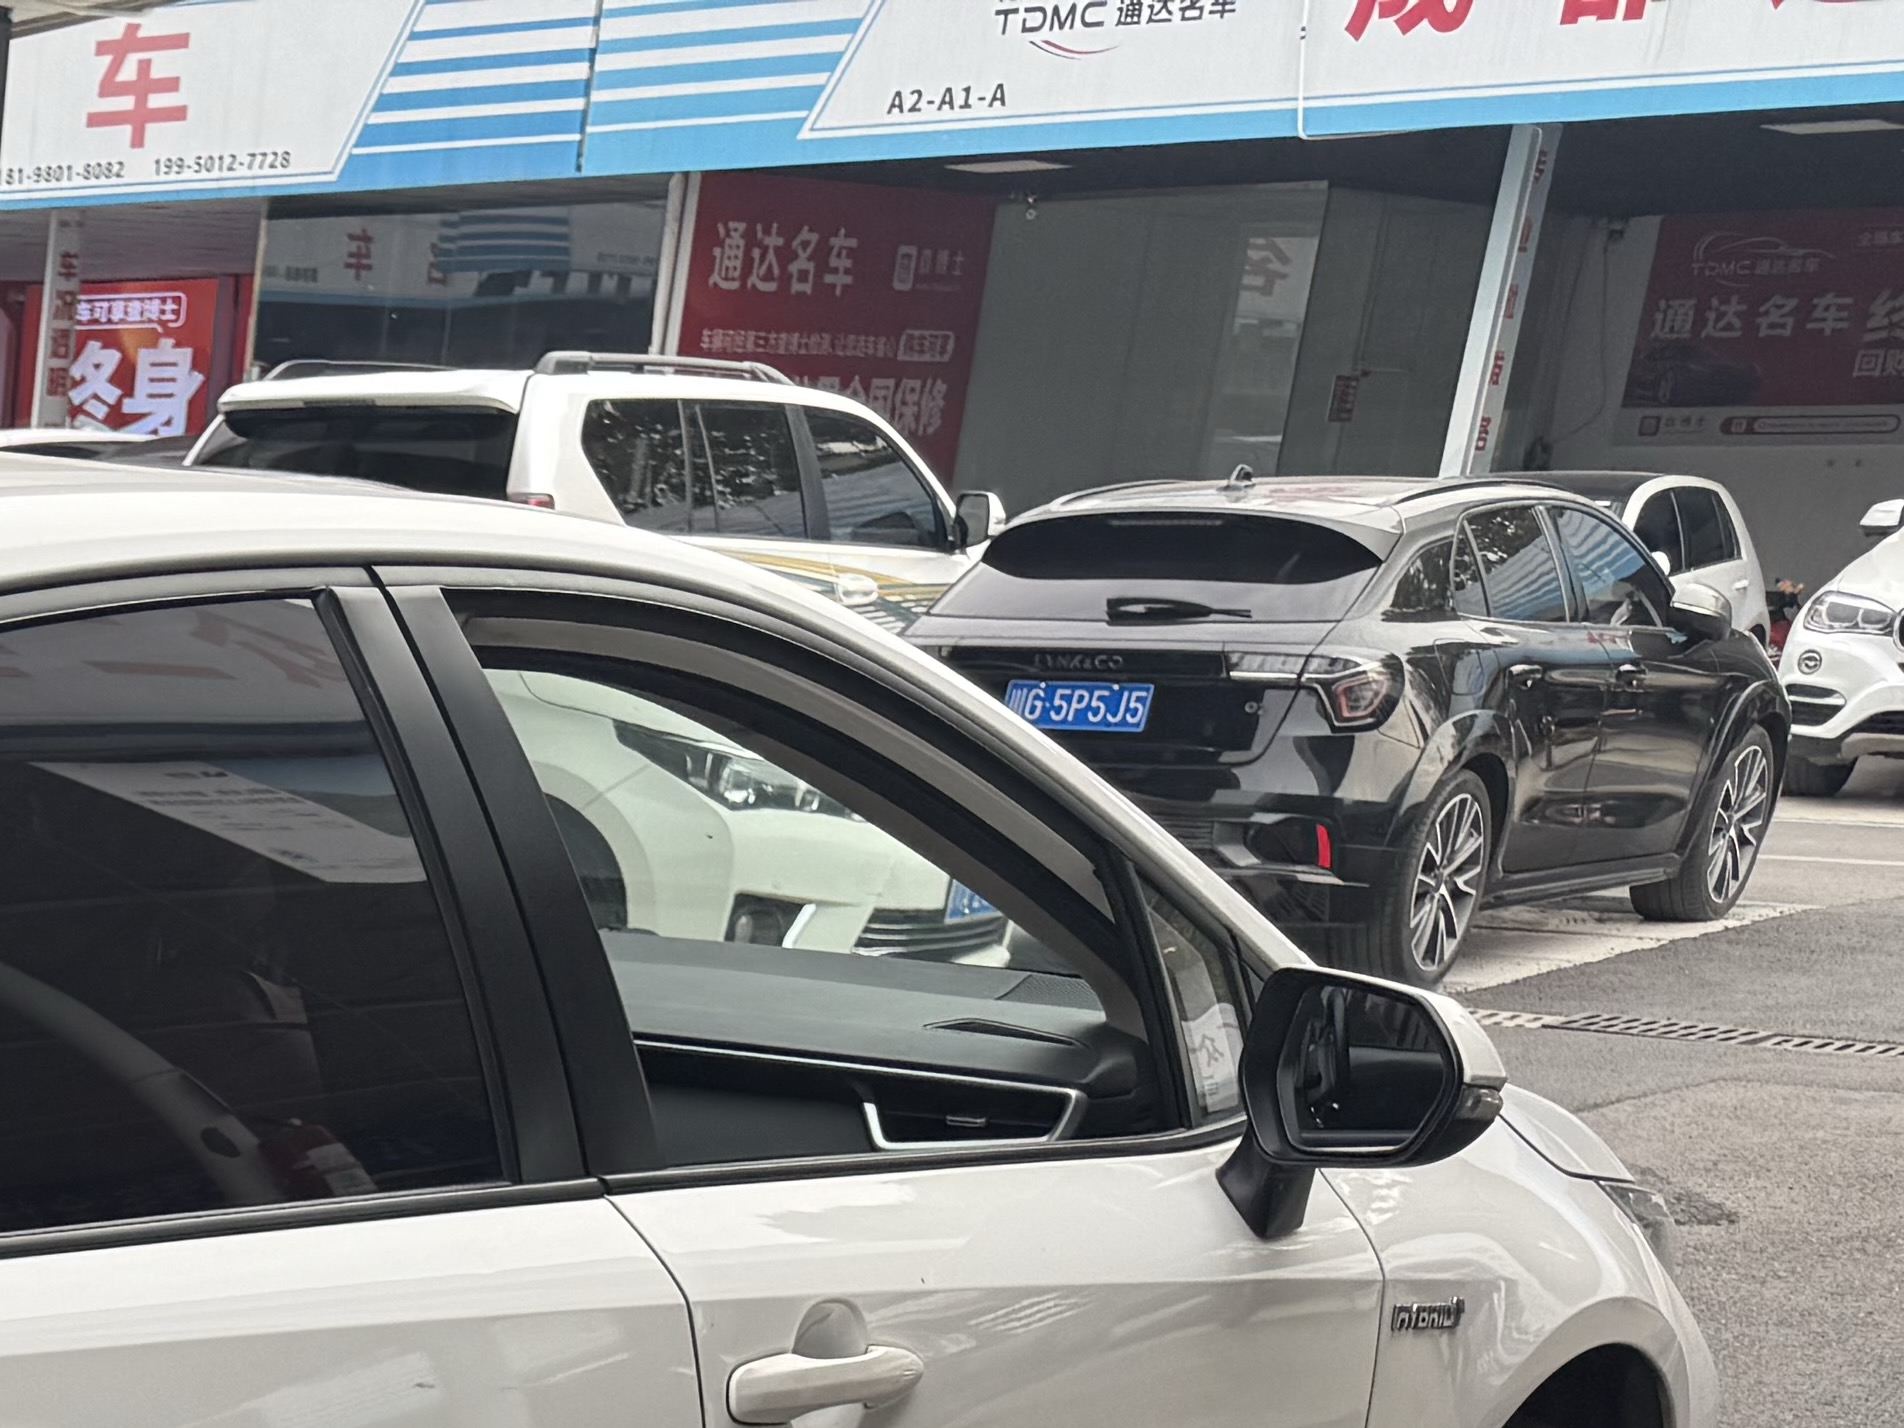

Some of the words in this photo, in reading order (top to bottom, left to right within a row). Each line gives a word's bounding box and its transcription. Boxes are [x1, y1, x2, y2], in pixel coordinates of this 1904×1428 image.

[994, 0, 1108, 35] TDMC
[86, 22, 191, 149] 车
[887, 83, 1007, 115] A2-A1-A
[154, 151, 292, 177] 199-5012-7728
[708, 221, 859, 297] 通达名车
[1650, 292, 1854, 340] 通达名车
